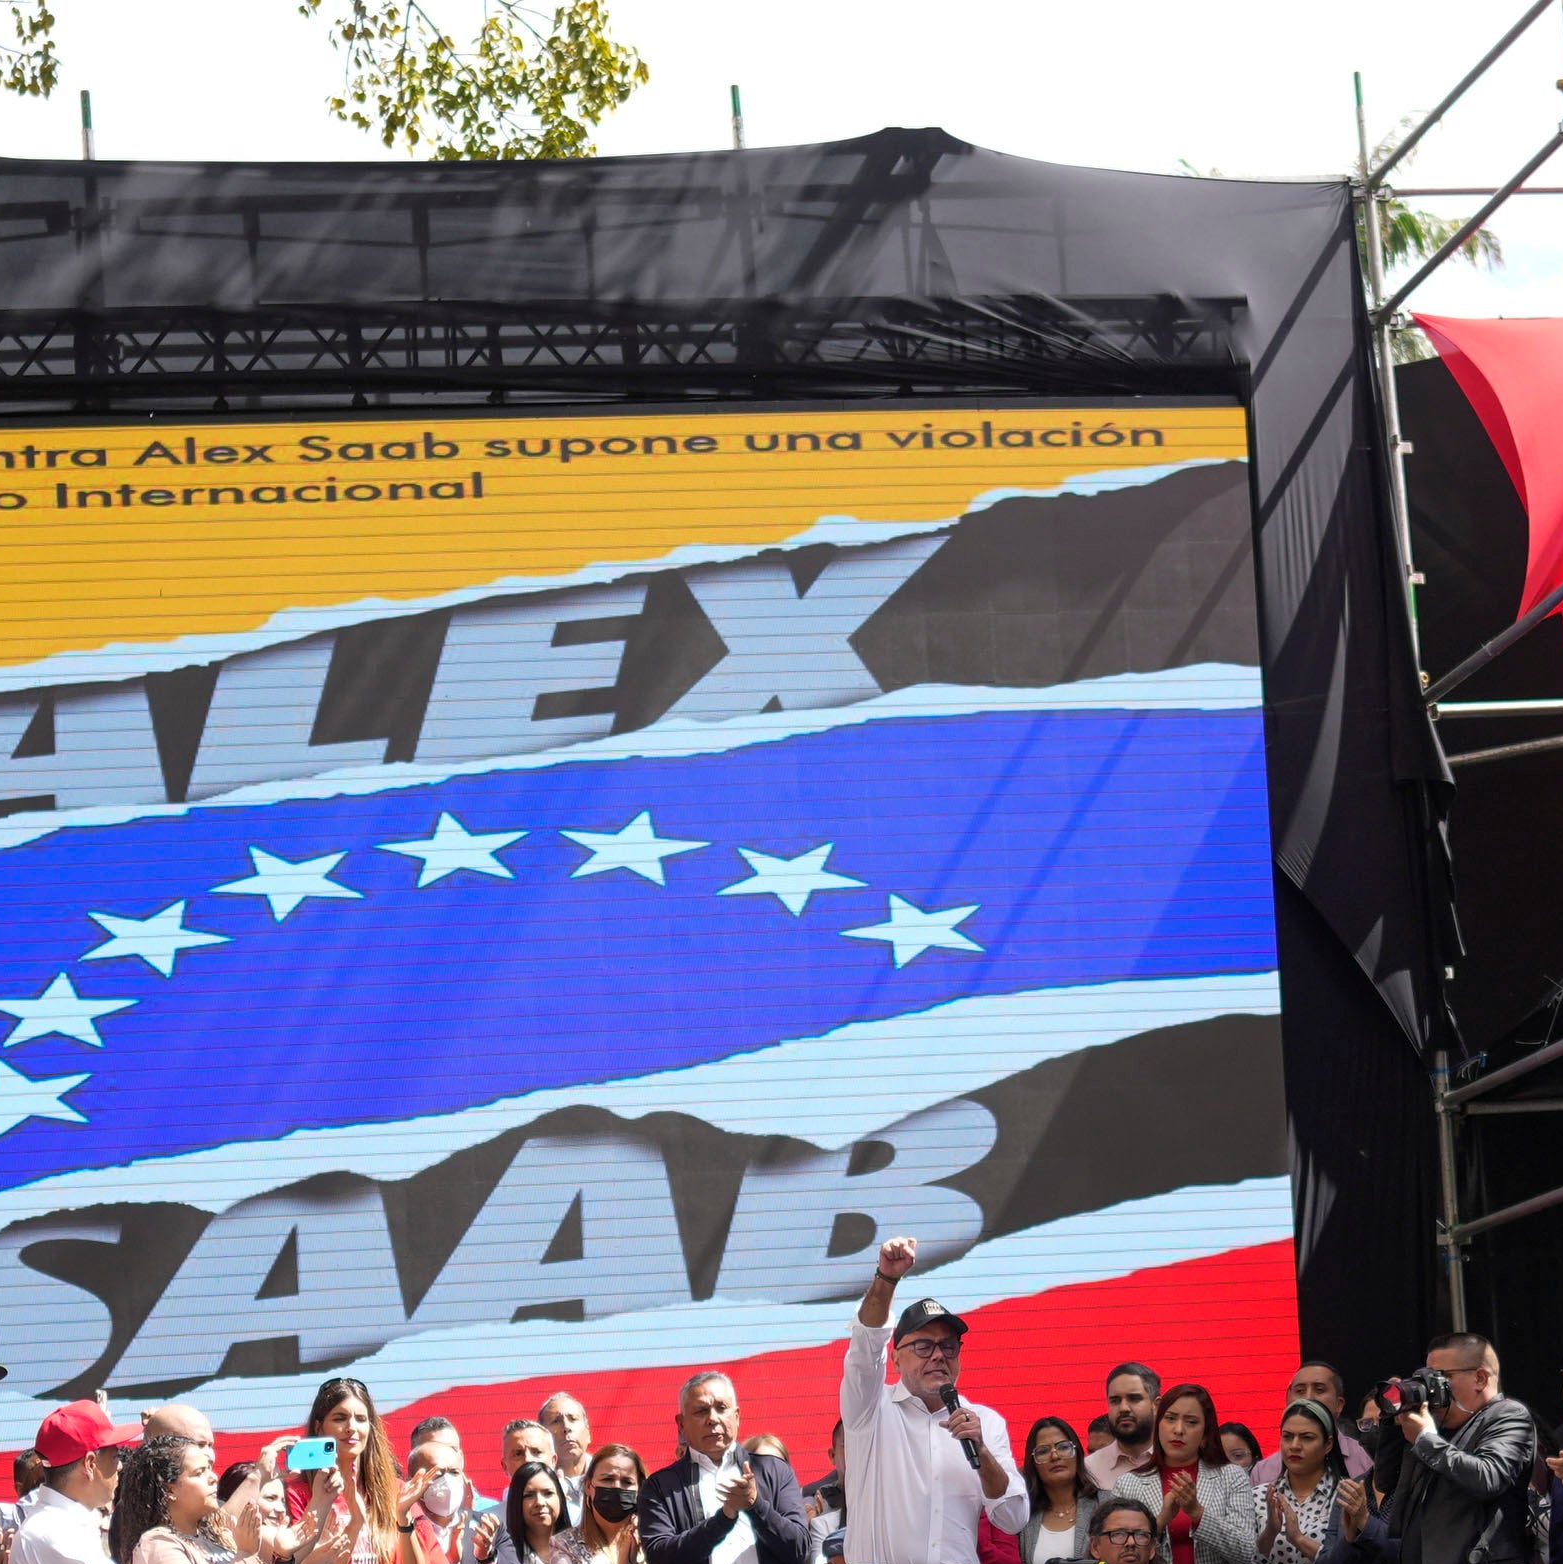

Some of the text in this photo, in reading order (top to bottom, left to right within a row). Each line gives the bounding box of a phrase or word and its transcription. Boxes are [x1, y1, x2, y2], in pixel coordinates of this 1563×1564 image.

[133, 436, 276, 465] Alex
[298, 431, 460, 462] Saab
[484, 434, 719, 463] supone
[744, 432, 862, 452] una
[886, 421, 1165, 449] violación
[56, 471, 483, 509] Internacional
